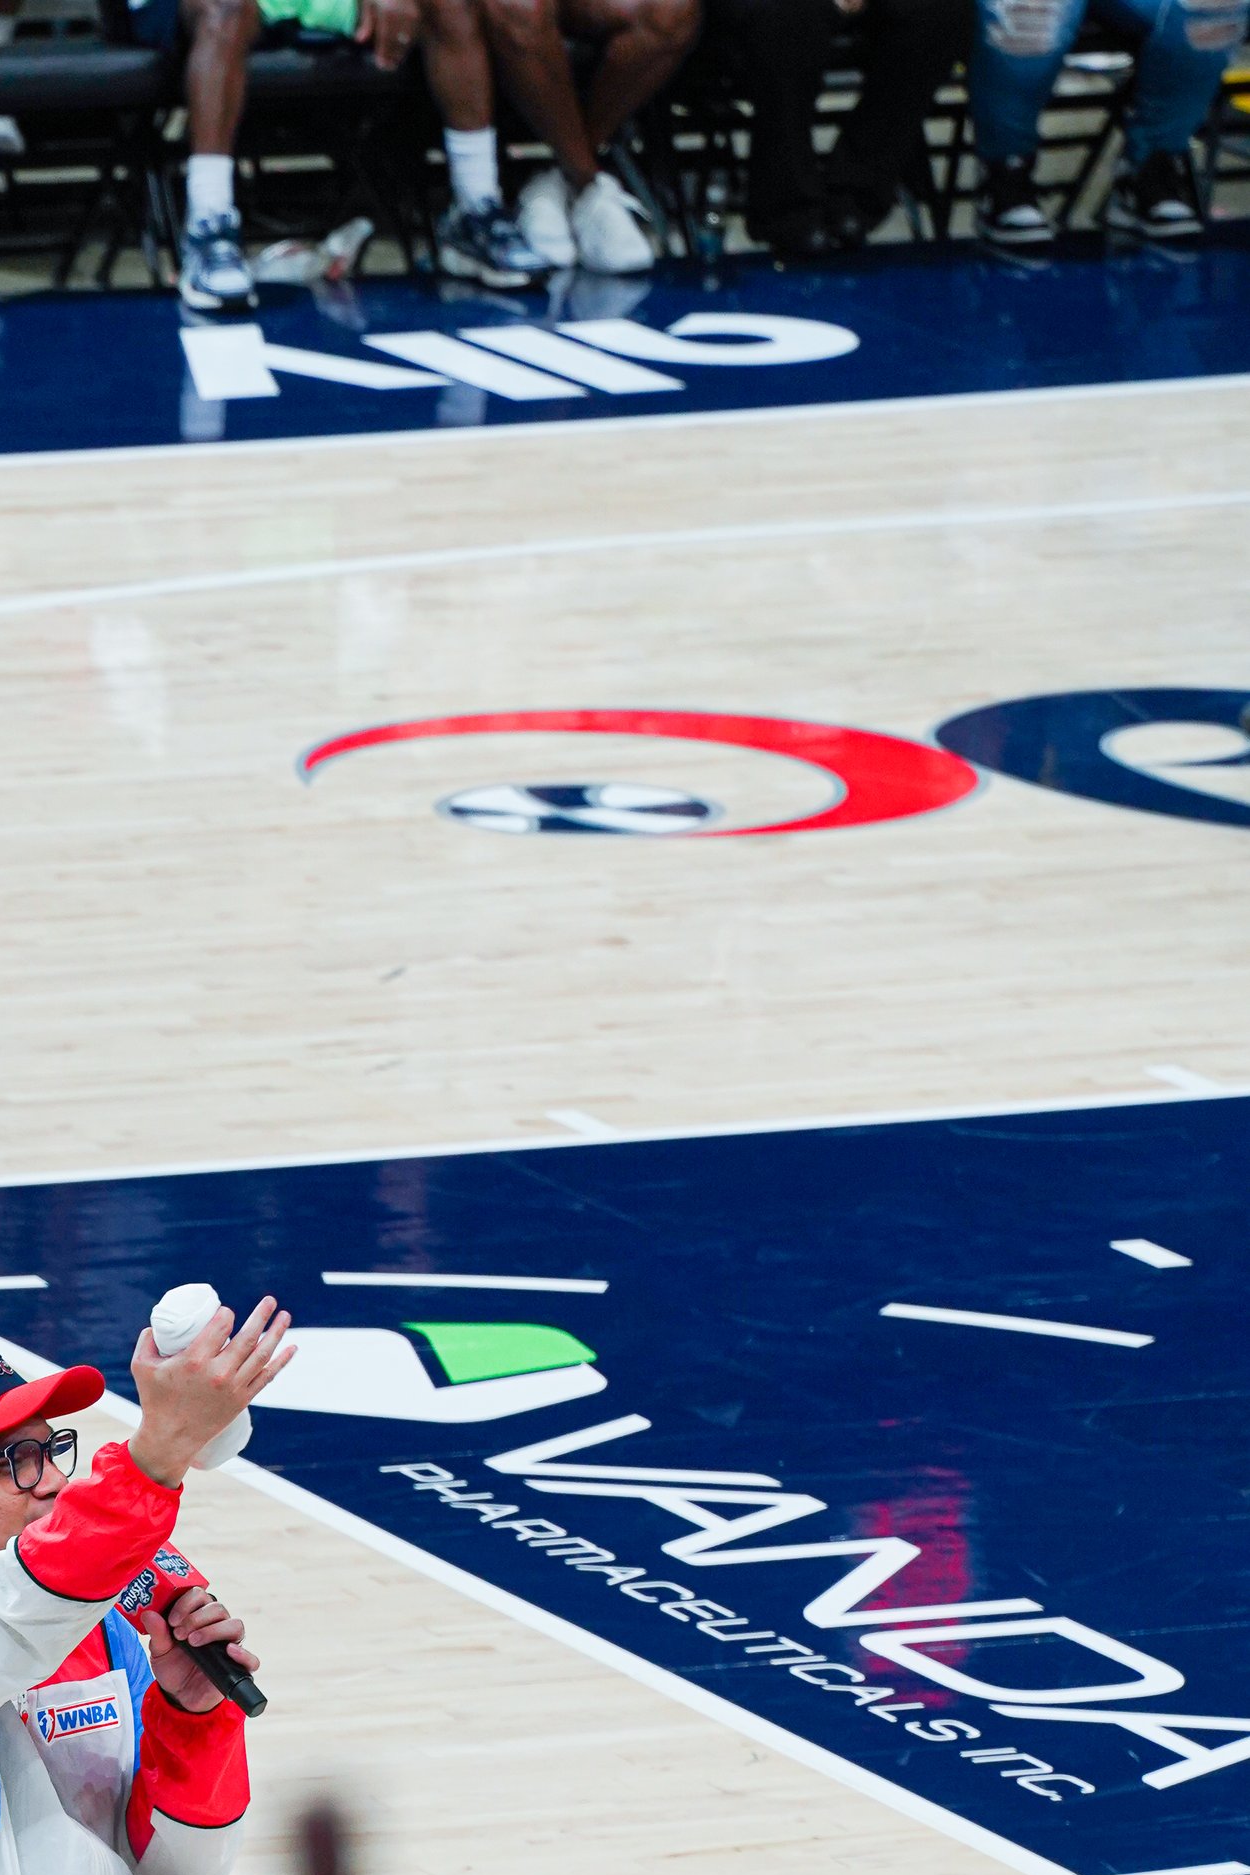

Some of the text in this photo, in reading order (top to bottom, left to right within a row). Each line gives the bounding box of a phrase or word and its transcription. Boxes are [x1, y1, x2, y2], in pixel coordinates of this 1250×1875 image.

[57, 1702, 118, 1731] WNBA
[379, 1462, 1096, 1801] PHARMACEUTICALS INC
[483, 1413, 1250, 1790] VANDA
